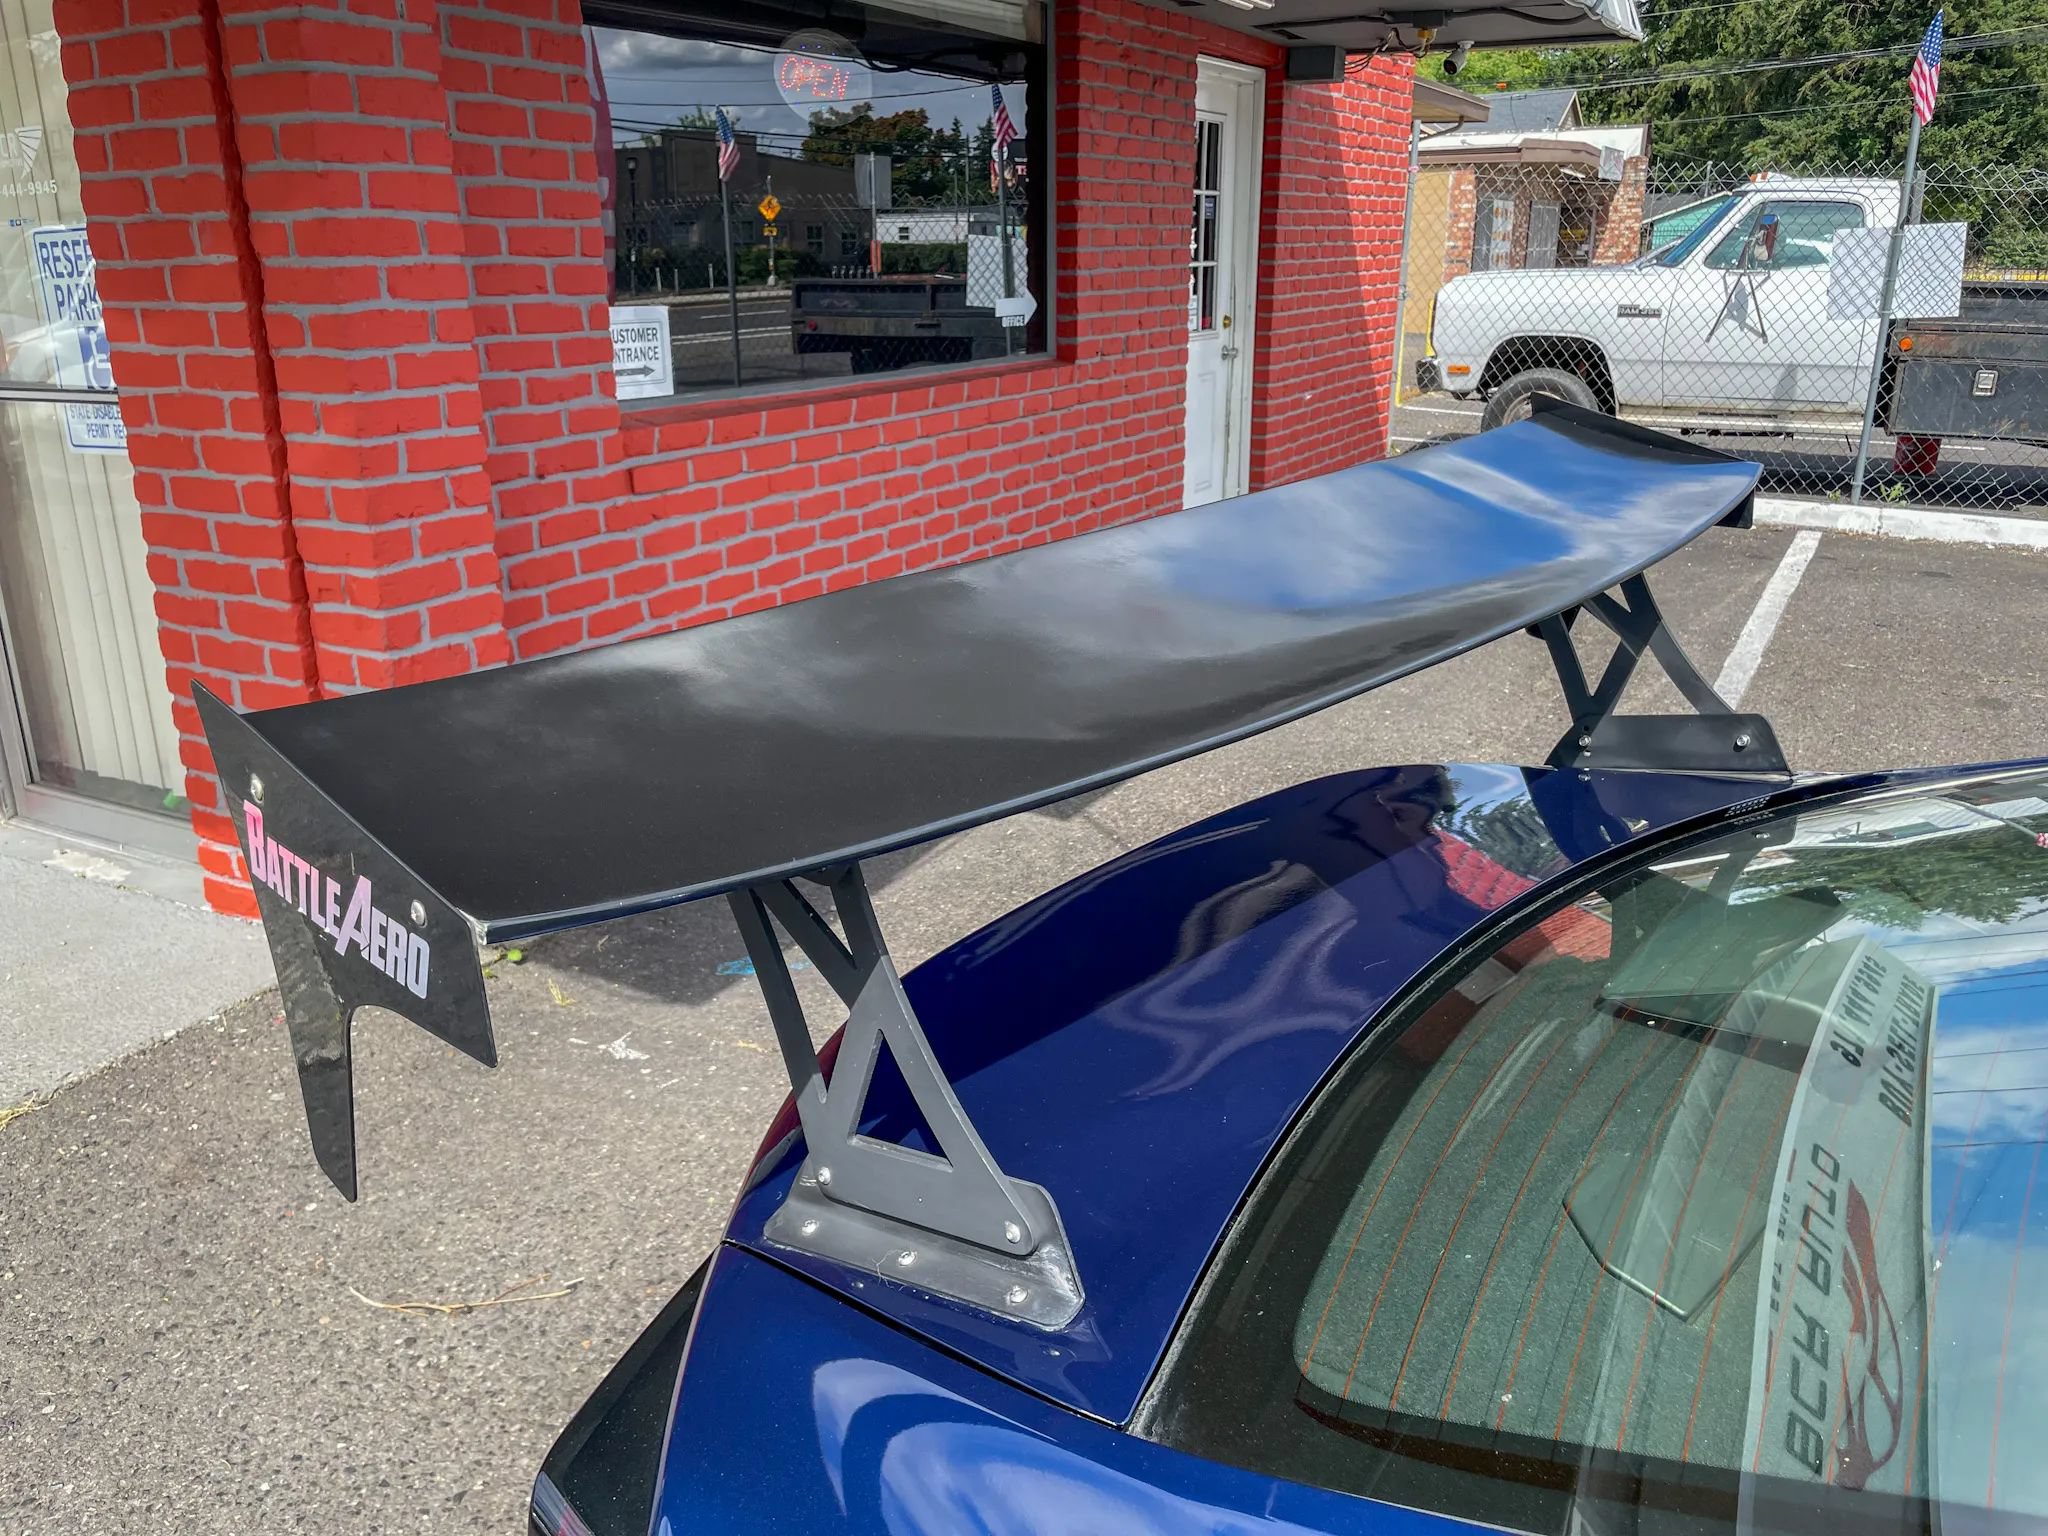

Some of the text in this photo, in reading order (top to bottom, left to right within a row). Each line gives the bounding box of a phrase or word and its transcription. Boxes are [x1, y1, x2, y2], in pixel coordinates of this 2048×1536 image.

[781, 56, 850, 101] OPEN
[0, 179, 58, 198] 444-9945
[53, 282, 103, 321] PARK
[611, 327, 659, 344] USTOMER
[614, 346, 660, 364] NTRANCE
[86, 423, 111, 438] PERMIT
